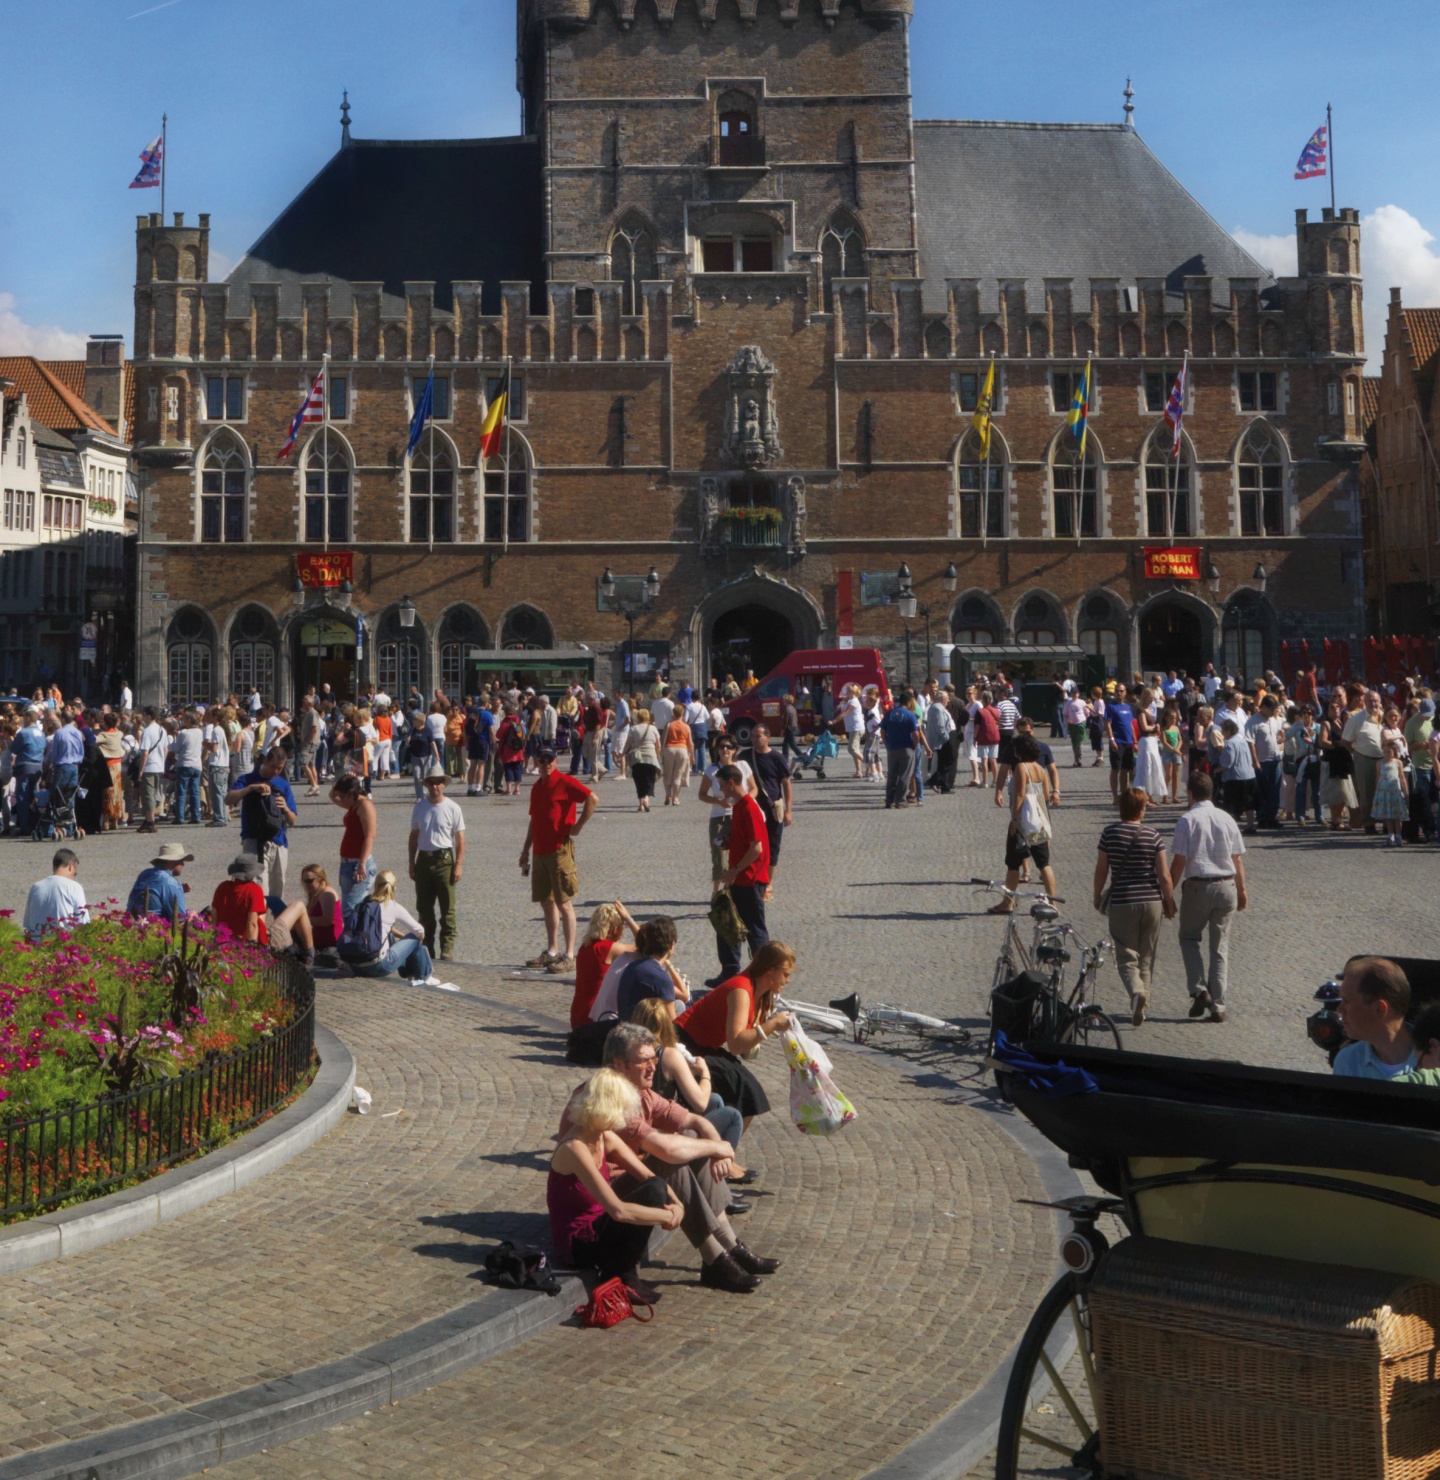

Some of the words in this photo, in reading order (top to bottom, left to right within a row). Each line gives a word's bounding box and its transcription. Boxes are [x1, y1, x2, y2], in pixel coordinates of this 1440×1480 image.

[310, 555, 341, 566] EXPO
[1152, 554, 1192, 563] ROBERT
[301, 568, 315, 582] S.
[318, 566, 350, 581] DALI
[1153, 565, 1166, 574] DE
[1169, 565, 1194, 575] MAN
